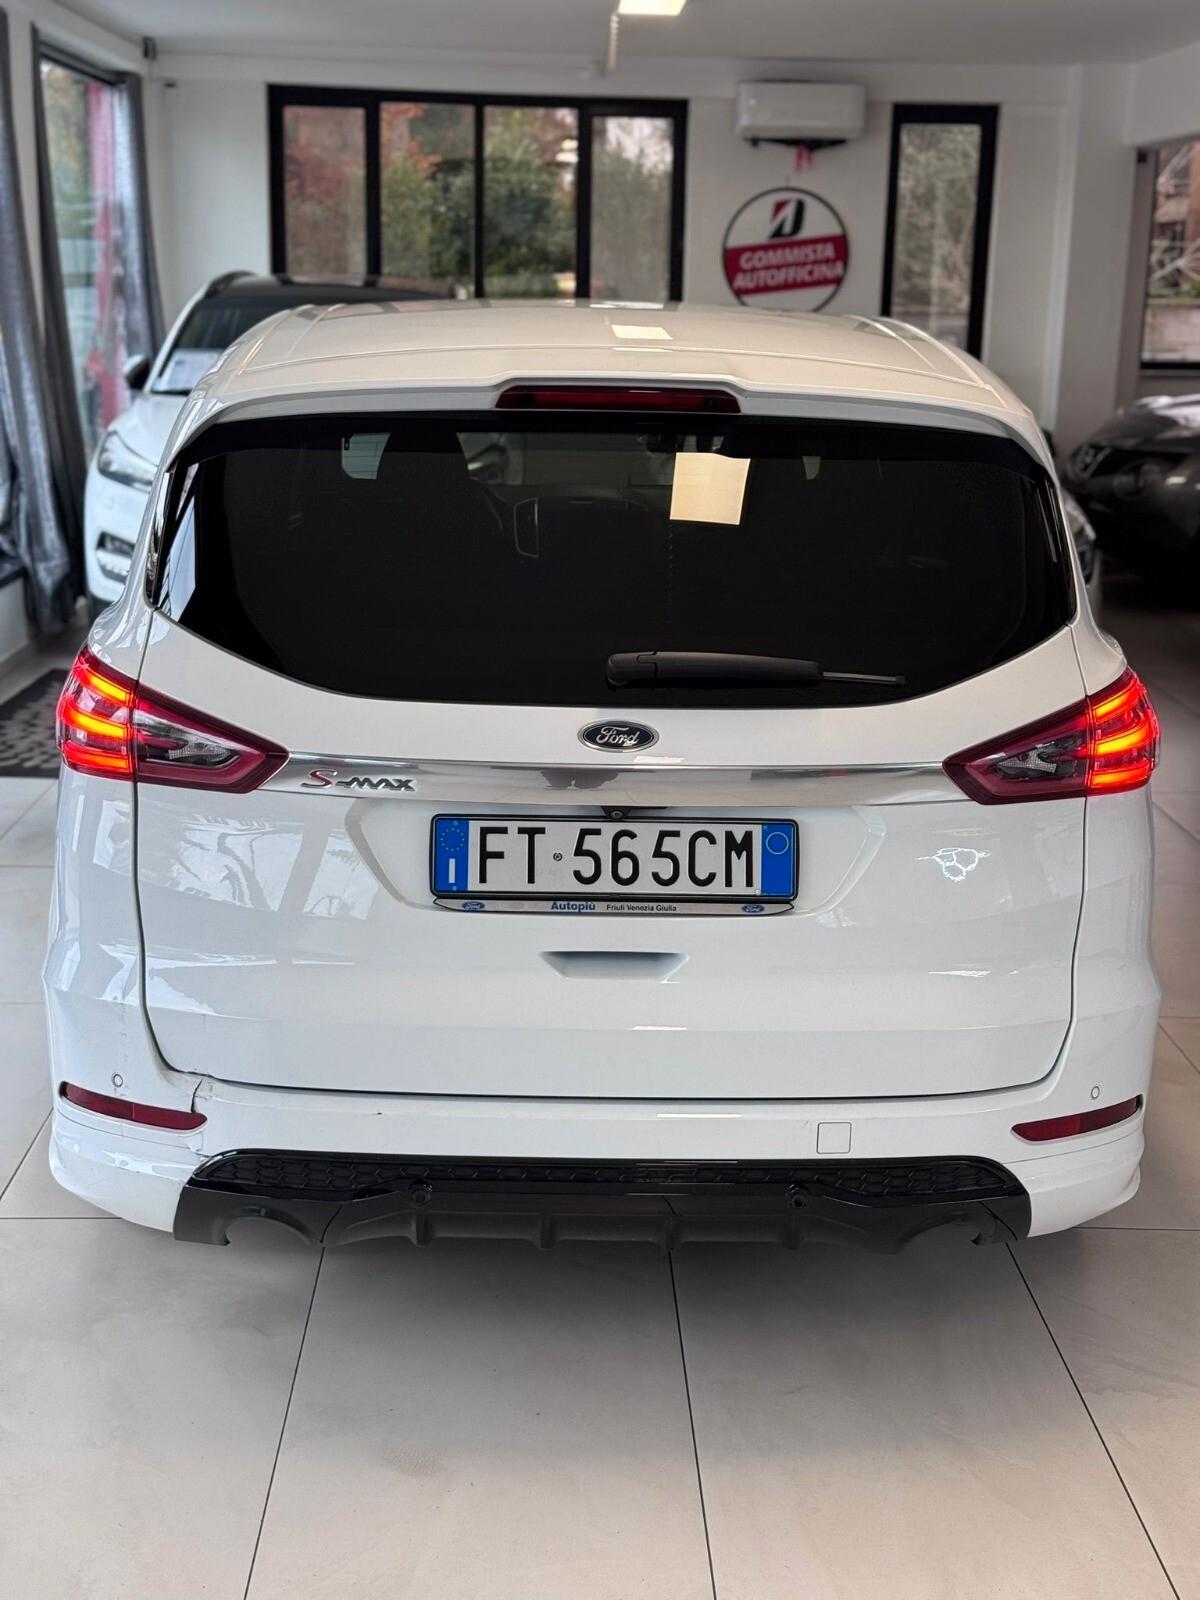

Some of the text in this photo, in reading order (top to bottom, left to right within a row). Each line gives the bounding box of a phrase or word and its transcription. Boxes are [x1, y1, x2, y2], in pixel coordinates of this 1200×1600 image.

[739, 242, 835, 270] GOMMISTA
[733, 262, 844, 289] AUTOFFICINA
[596, 726, 640, 746] Ford
[300, 769, 416, 792] S-MAX
[478, 826, 755, 888] FT 565CM
[551, 901, 596, 913] Autopiù
[627, 904, 655, 912] Venezia
